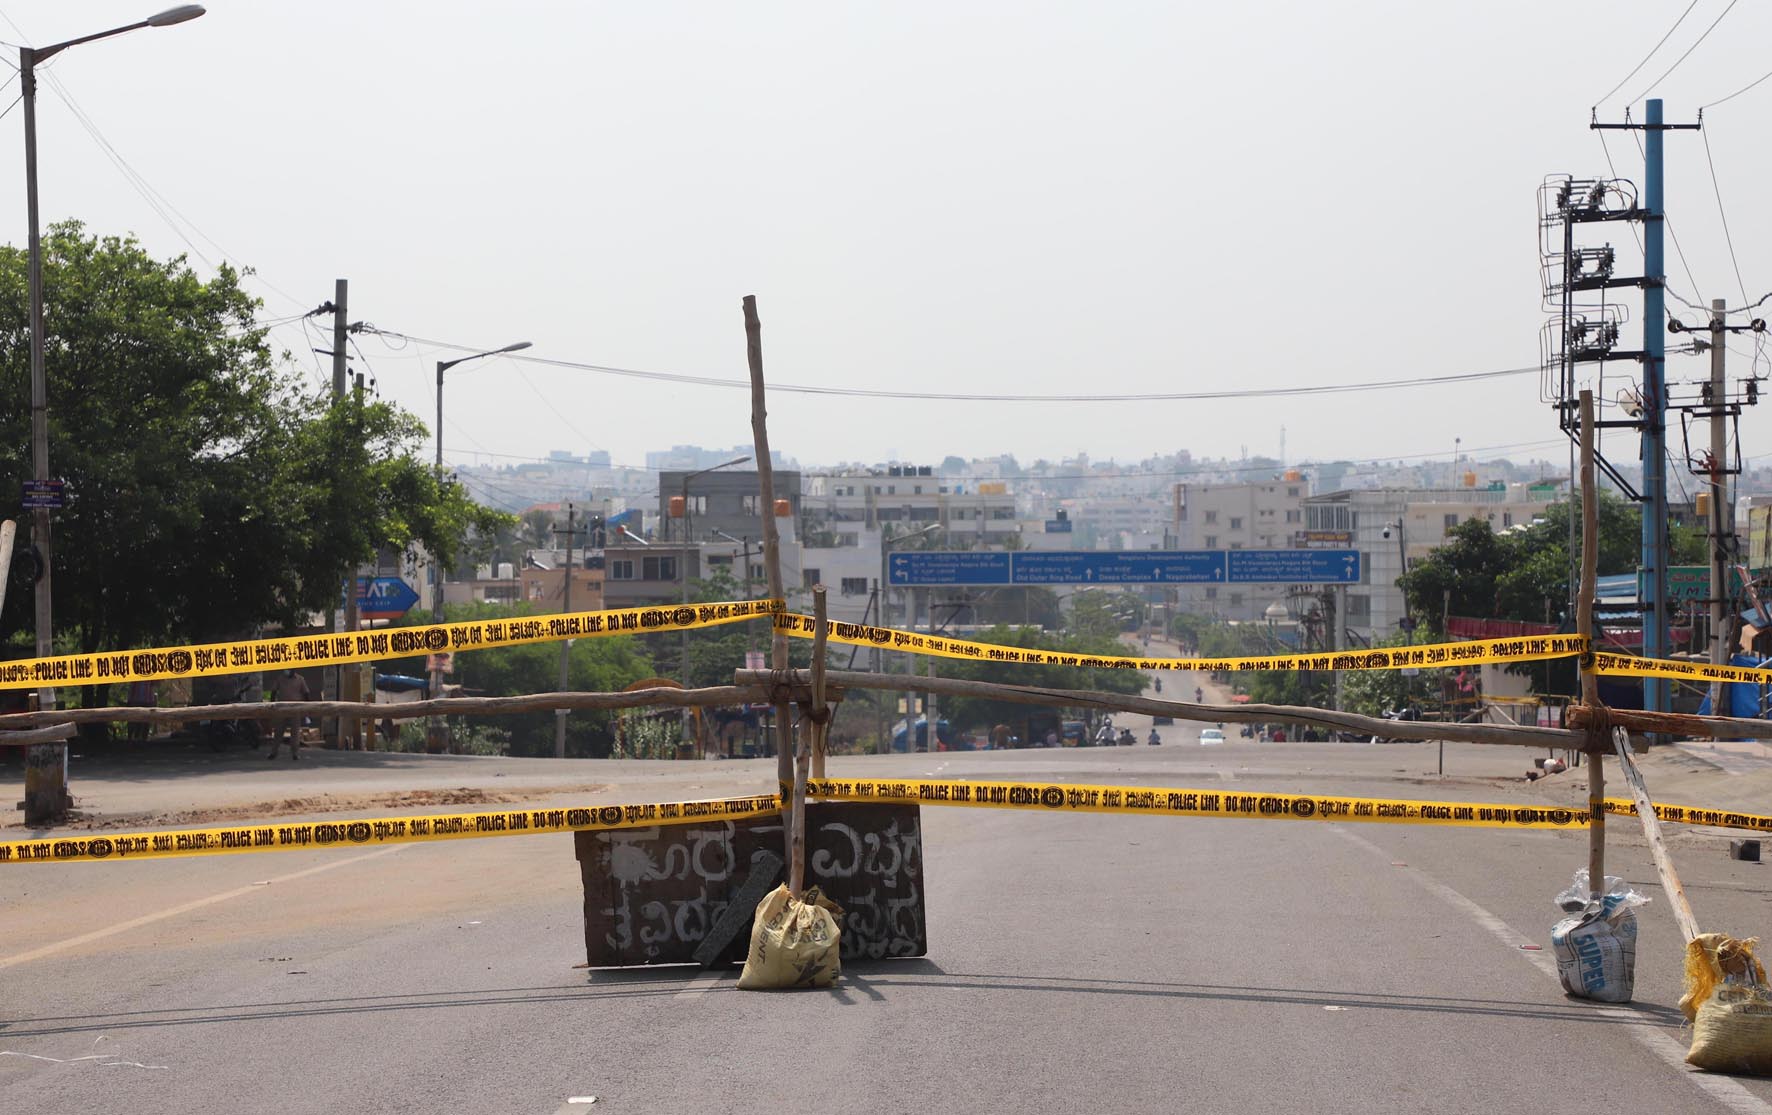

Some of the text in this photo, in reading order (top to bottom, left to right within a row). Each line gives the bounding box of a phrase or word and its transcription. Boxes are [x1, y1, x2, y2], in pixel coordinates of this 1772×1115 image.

[550, 617, 580, 636] POLICE
[582, 615, 602, 632] LINE
[607, 614, 620, 631] DO
[621, 612, 638, 630] NOT
[298, 639, 329, 661] POLICE
[331, 636, 352, 658] LINE
[357, 636, 370, 655] DO
[371, 633, 389, 654] NOT
[1552, 639, 1564, 652] DO
[36, 661, 68, 680] POLICE
[70, 658, 92, 678] LINE
[97, 657, 110, 677] DO
[112, 656, 130, 677] NOT
[920, 784, 949, 800] POLICE
[951, 785, 970, 801] LINE
[976, 786, 988, 802] DO
[991, 786, 1007, 803] NOT
[1010, 787, 1039, 805] CROSS
[1168, 793, 1198, 810] POLICE
[1200, 794, 1220, 812] LINE
[1225, 796, 1238, 812] DO
[1239, 796, 1257, 813] NOT
[1260, 797, 1289, 815] CROSS
[476, 815, 506, 832] POLICE
[508, 812, 528, 830] LINE
[533, 811, 546, 828] DO
[547, 810, 564, 827] NOT
[567, 808, 597, 826] CROSS
[1421, 806, 1452, 820] POLICE
[1454, 807, 1474, 821] LINE
[221, 831, 251, 848] POLICE
[254, 829, 274, 846] LINE
[280, 828, 293, 845] DO
[295, 826, 312, 843] NOT
[315, 824, 345, 842] CROSS
[17, 844, 31, 859] DO
[33, 843, 51, 859] NOT
[1572, 933, 1607, 993] SUPER
